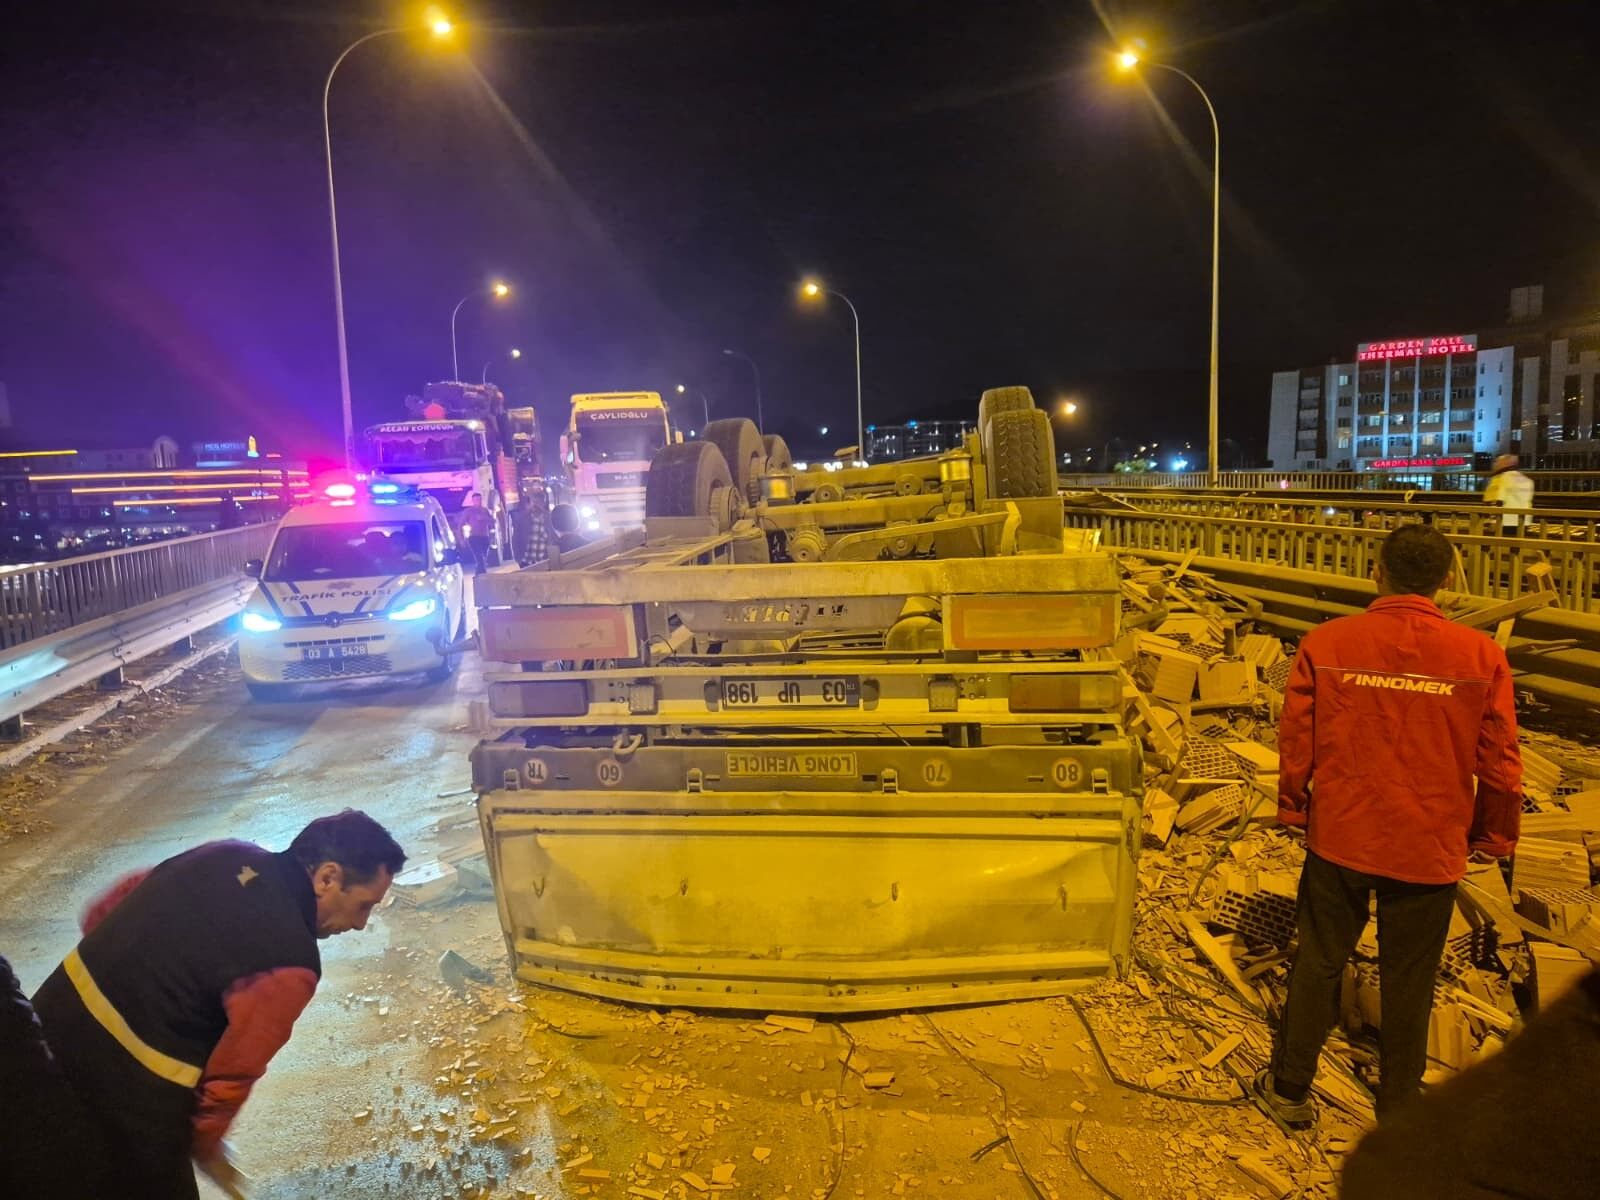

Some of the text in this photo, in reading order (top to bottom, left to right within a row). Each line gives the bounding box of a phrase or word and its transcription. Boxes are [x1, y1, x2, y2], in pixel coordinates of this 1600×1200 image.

[1360, 344, 1475, 360] THERMAL HOTEL
[1369, 336, 1464, 351] GARDEN KALE
[308, 649, 321, 659] 03
[328, 648, 335, 658] A
[727, 680, 846, 703] 03 UP 198
[527, 762, 545, 780] TR
[600, 763, 619, 781] 60
[729, 754, 852, 773] LONG VEHICLE
[925, 763, 946, 782] 70
[1056, 763, 1078, 782] 80
